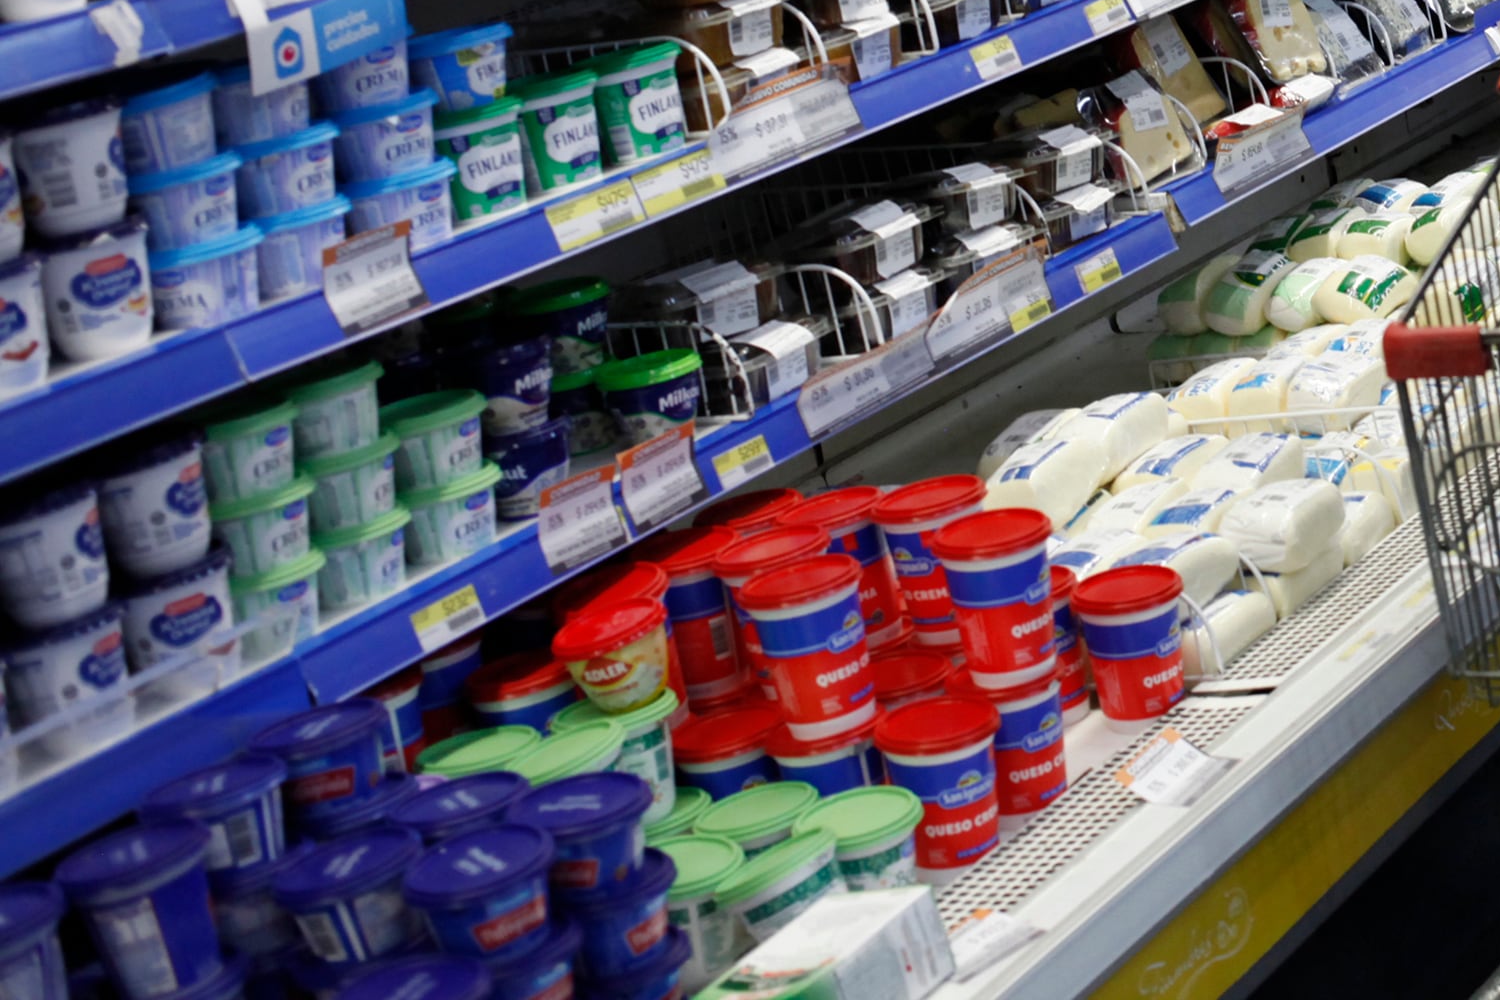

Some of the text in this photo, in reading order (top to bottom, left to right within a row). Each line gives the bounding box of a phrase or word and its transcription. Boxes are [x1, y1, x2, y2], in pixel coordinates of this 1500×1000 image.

[816, 664, 858, 688] QUESO
[1009, 763, 1044, 783] QUESO
[924, 816, 972, 839] QUESO
